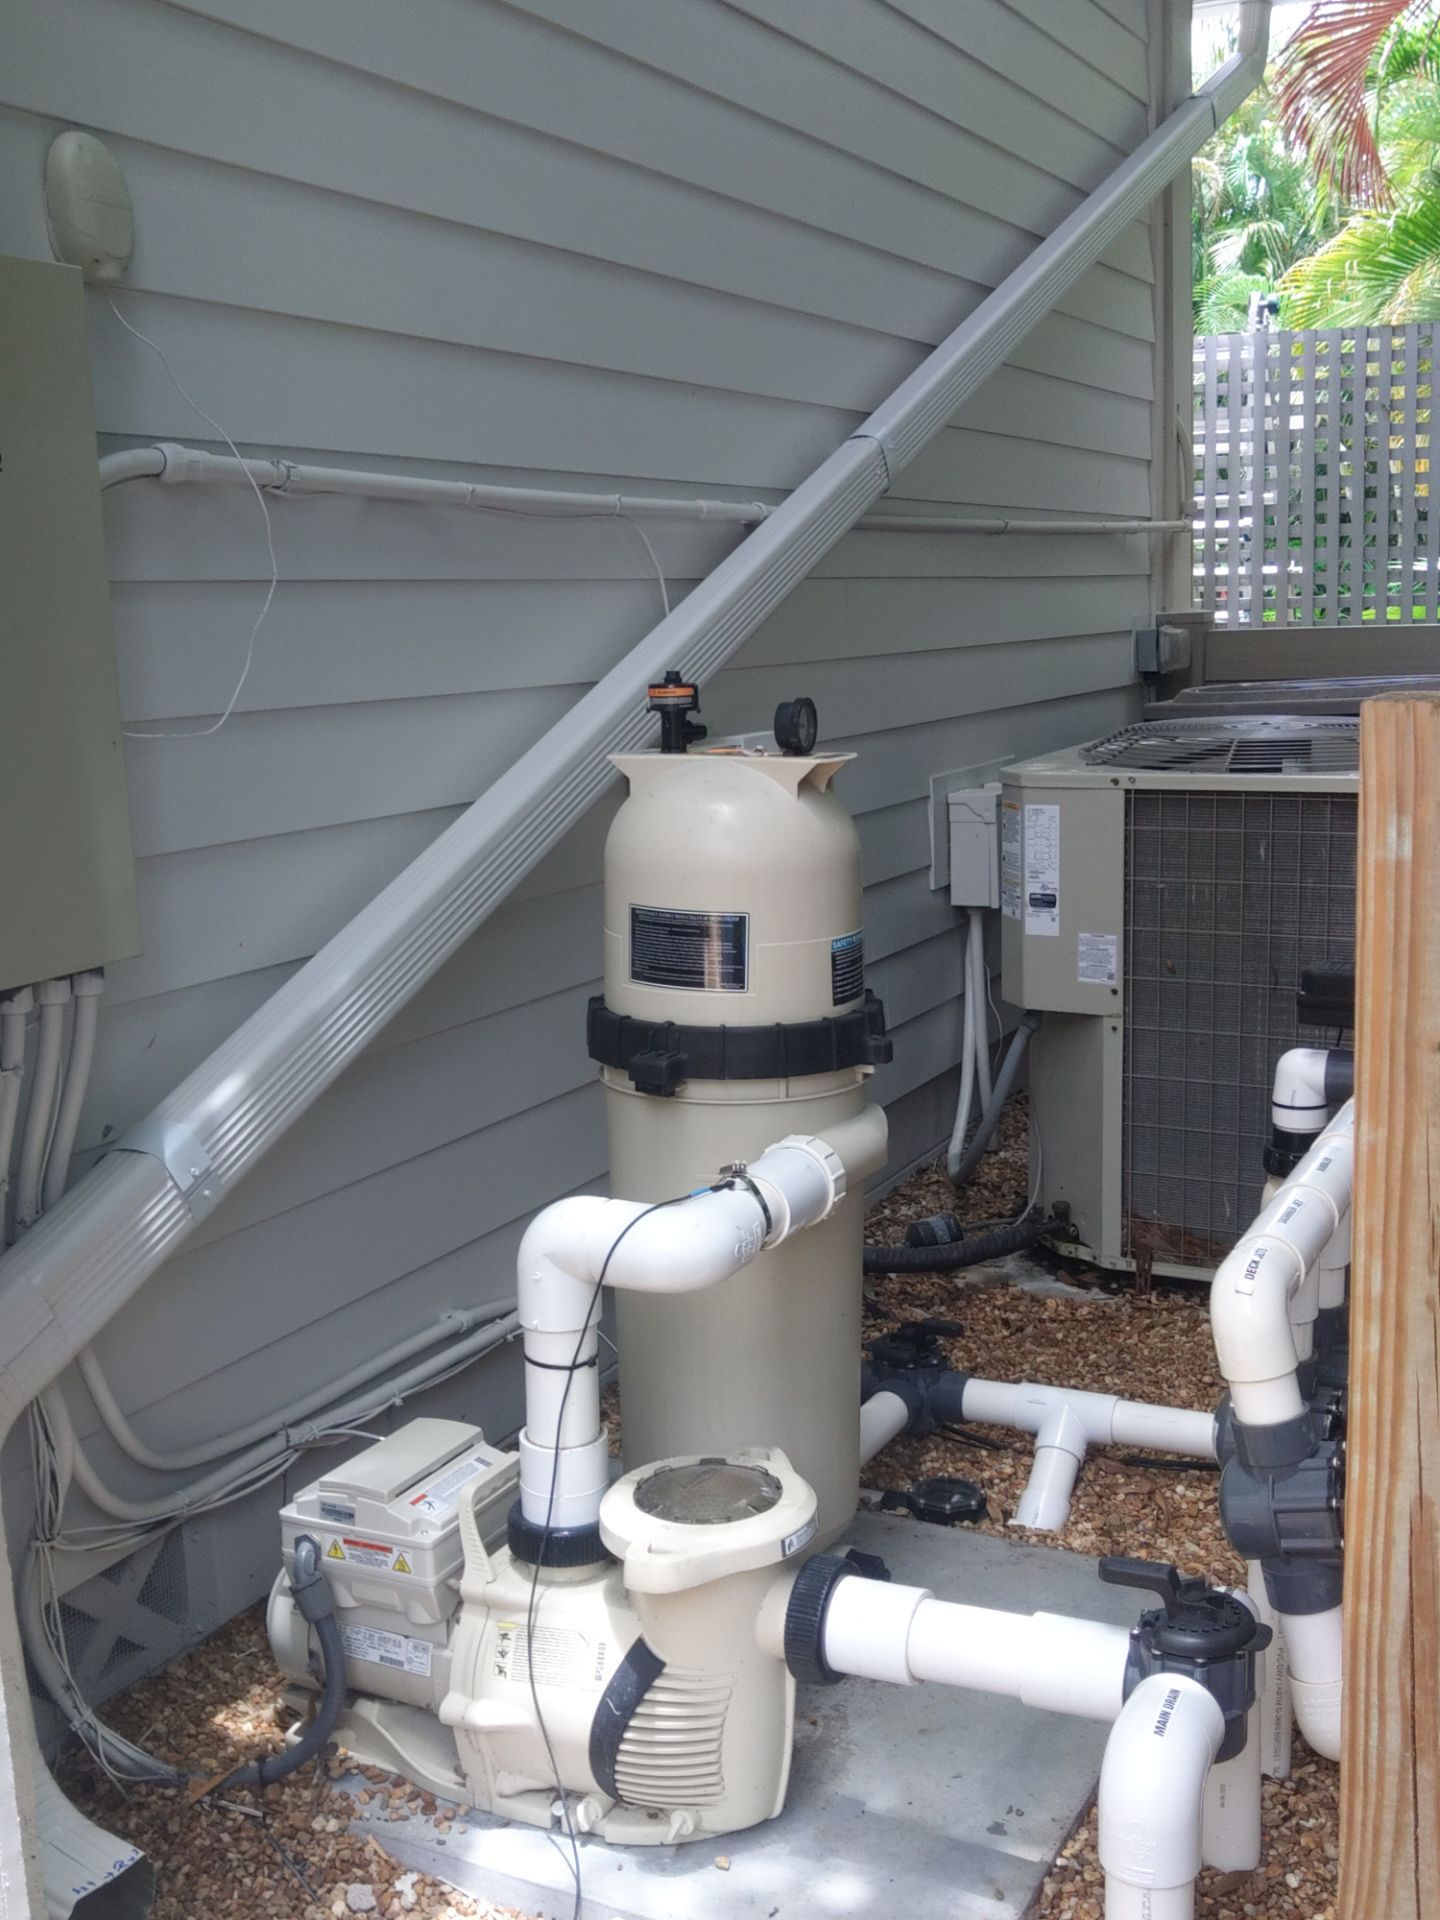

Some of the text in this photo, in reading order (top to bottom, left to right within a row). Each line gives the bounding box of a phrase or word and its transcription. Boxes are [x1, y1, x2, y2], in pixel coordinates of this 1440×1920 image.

[1244, 1259, 1261, 1280] DECK
[1153, 1688, 1181, 1737] MAIN DRAIN
